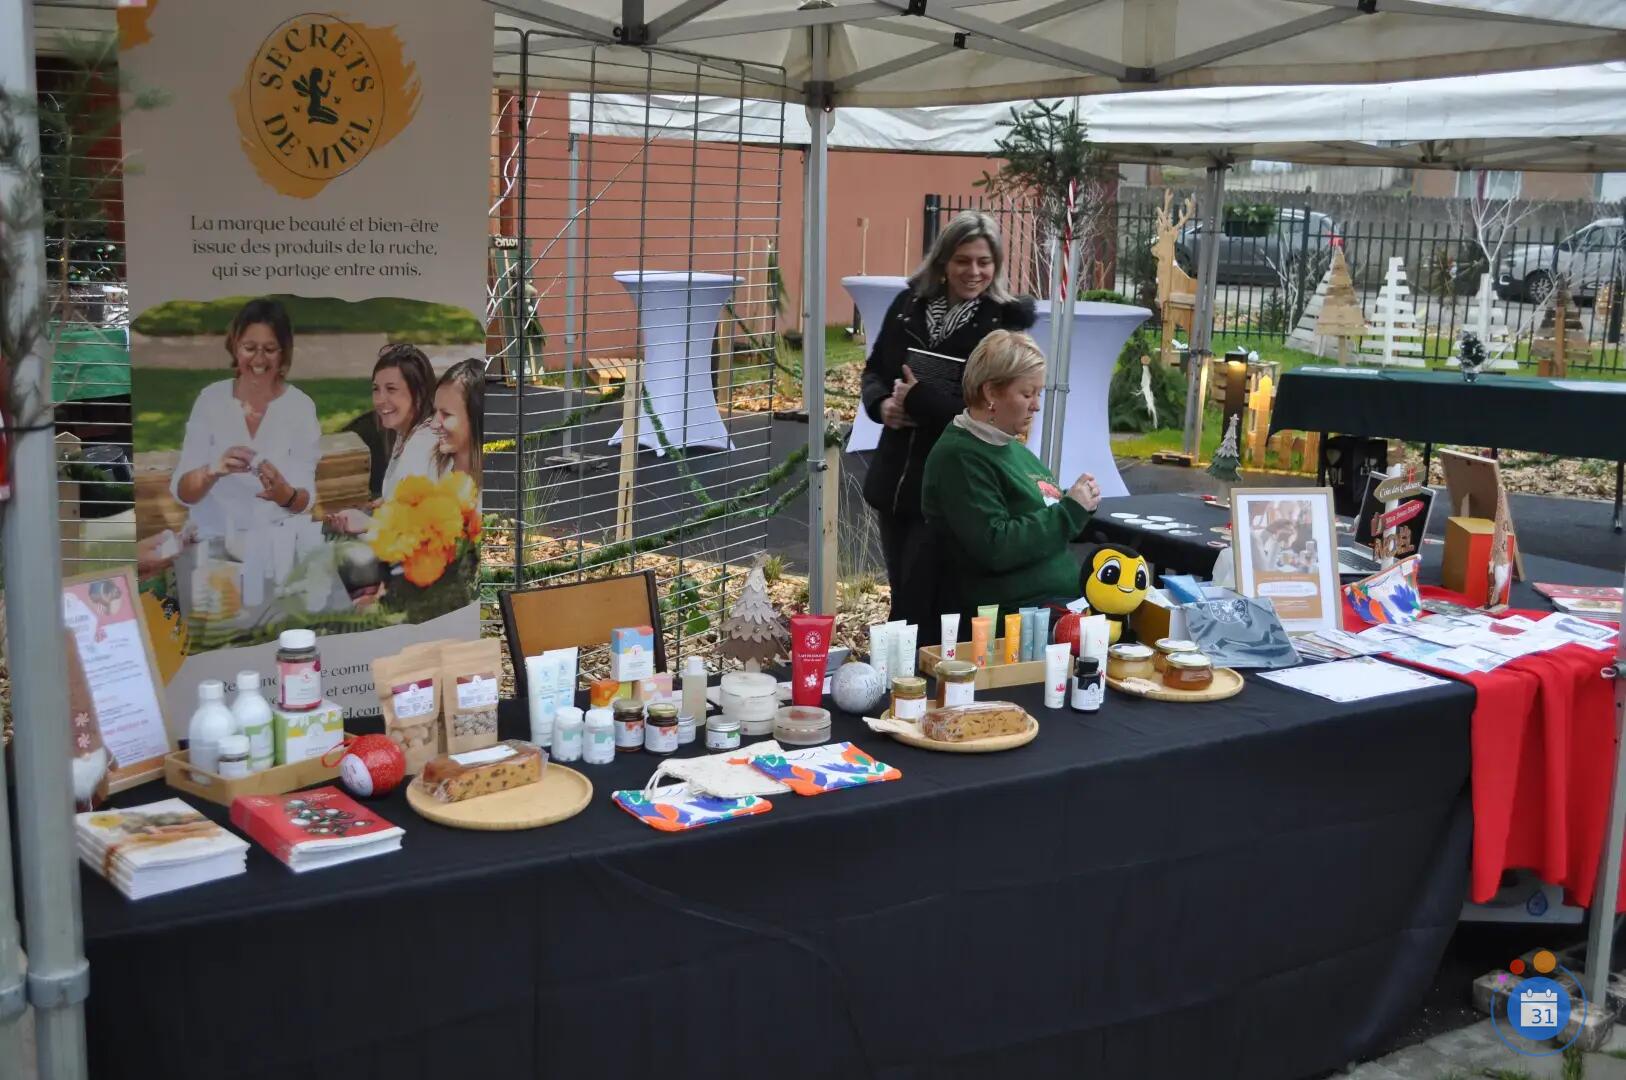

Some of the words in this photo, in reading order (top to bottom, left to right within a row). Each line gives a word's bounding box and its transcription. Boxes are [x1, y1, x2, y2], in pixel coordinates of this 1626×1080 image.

[259, 24, 375, 92] SECRETS
[264, 112, 301, 157] DE
[306, 118, 374, 169] MIEL
[190, 215, 214, 231] La
[218, 218, 285, 235] marque
[288, 216, 346, 233] beauté
[350, 218, 363, 232] et
[368, 217, 440, 233] bien-être
[193, 239, 237, 254] issue
[241, 238, 271, 254] des
[276, 239, 343, 258] produits
[346, 238, 367, 254] de
[370, 239, 384, 254] la
[211, 262, 238, 281] qui
[242, 265, 261, 277] se
[265, 263, 331, 281] partage
[334, 263, 376, 277] entre
[380, 262, 422, 277] amis.
[326, 686, 338, 697] et
[342, 682, 376, 695] enga
